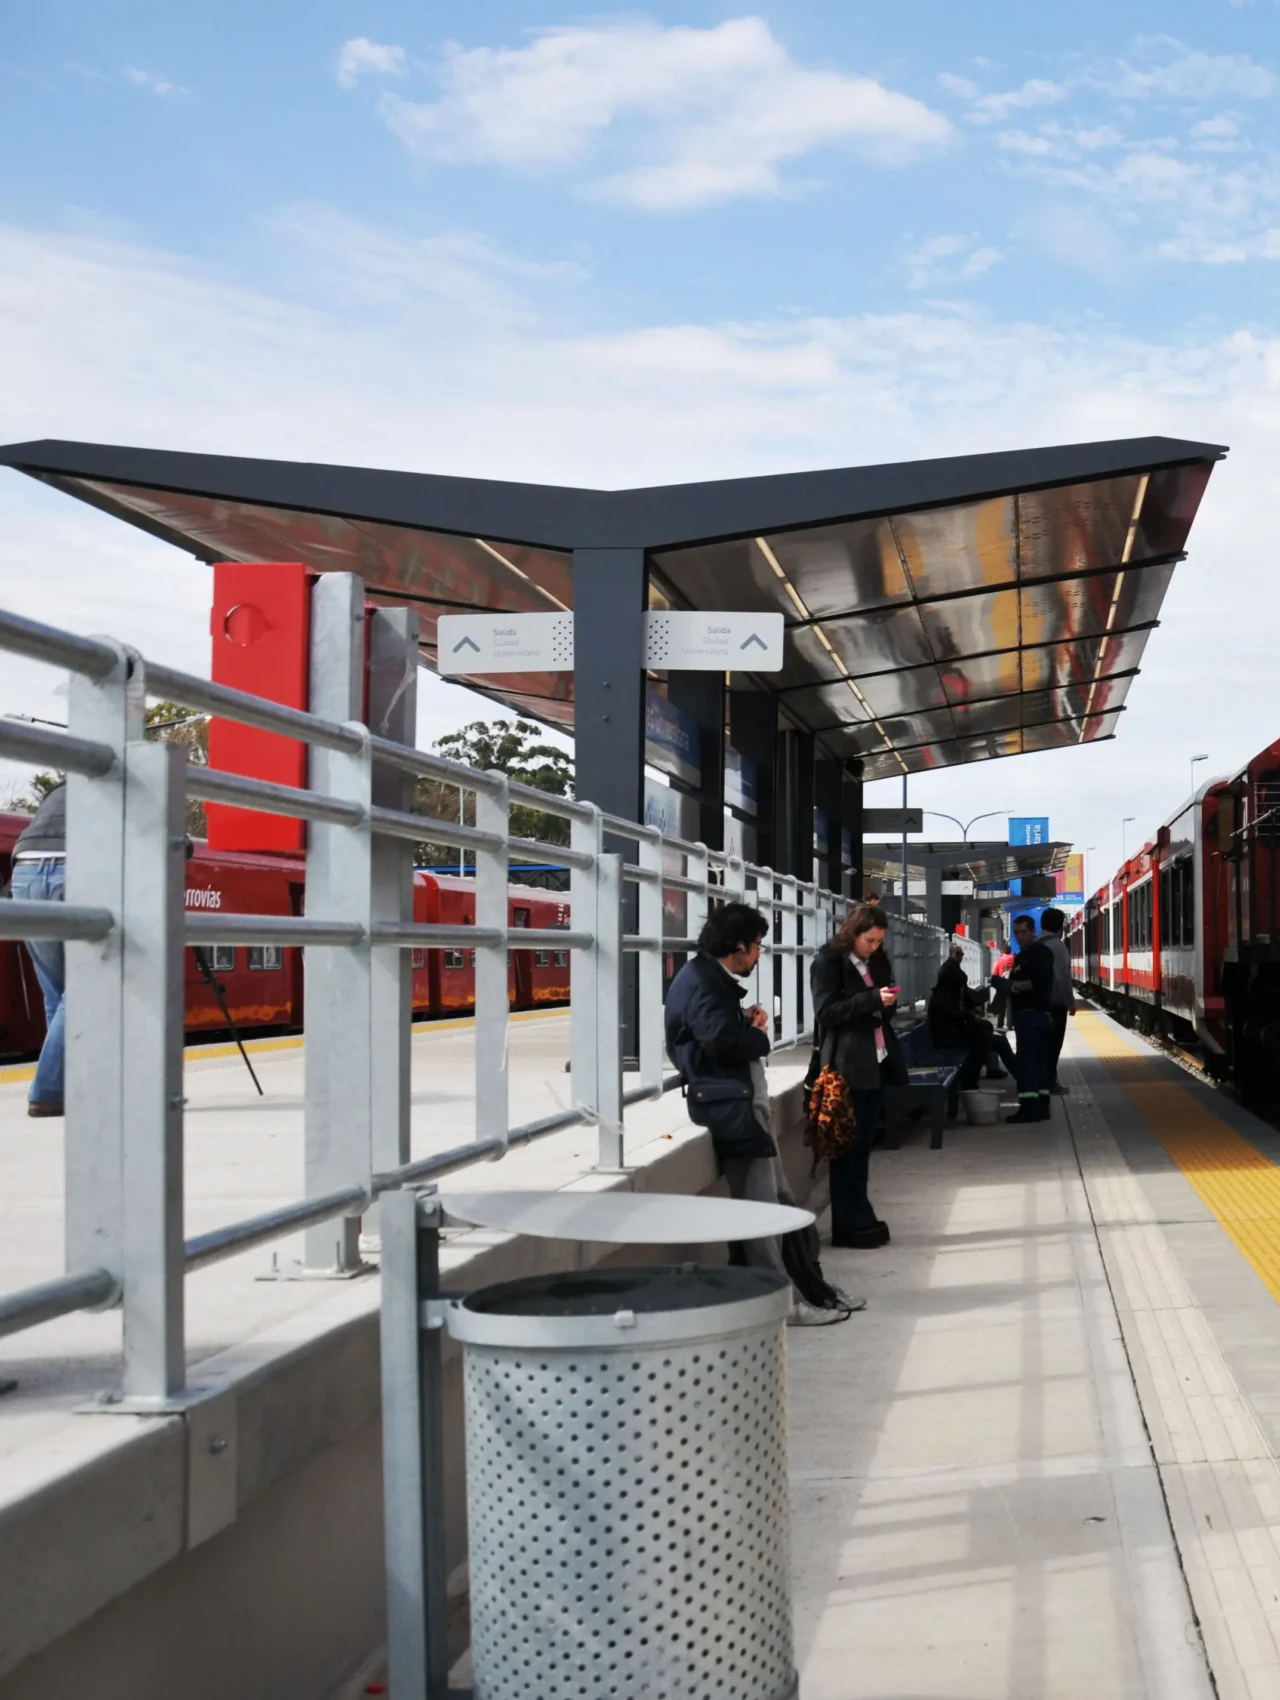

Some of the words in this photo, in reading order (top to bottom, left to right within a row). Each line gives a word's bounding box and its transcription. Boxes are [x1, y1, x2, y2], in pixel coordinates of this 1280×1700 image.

[493, 628, 517, 637] Salida
[707, 626, 731, 634] Salida
[184, 884, 221, 908] rrovías
